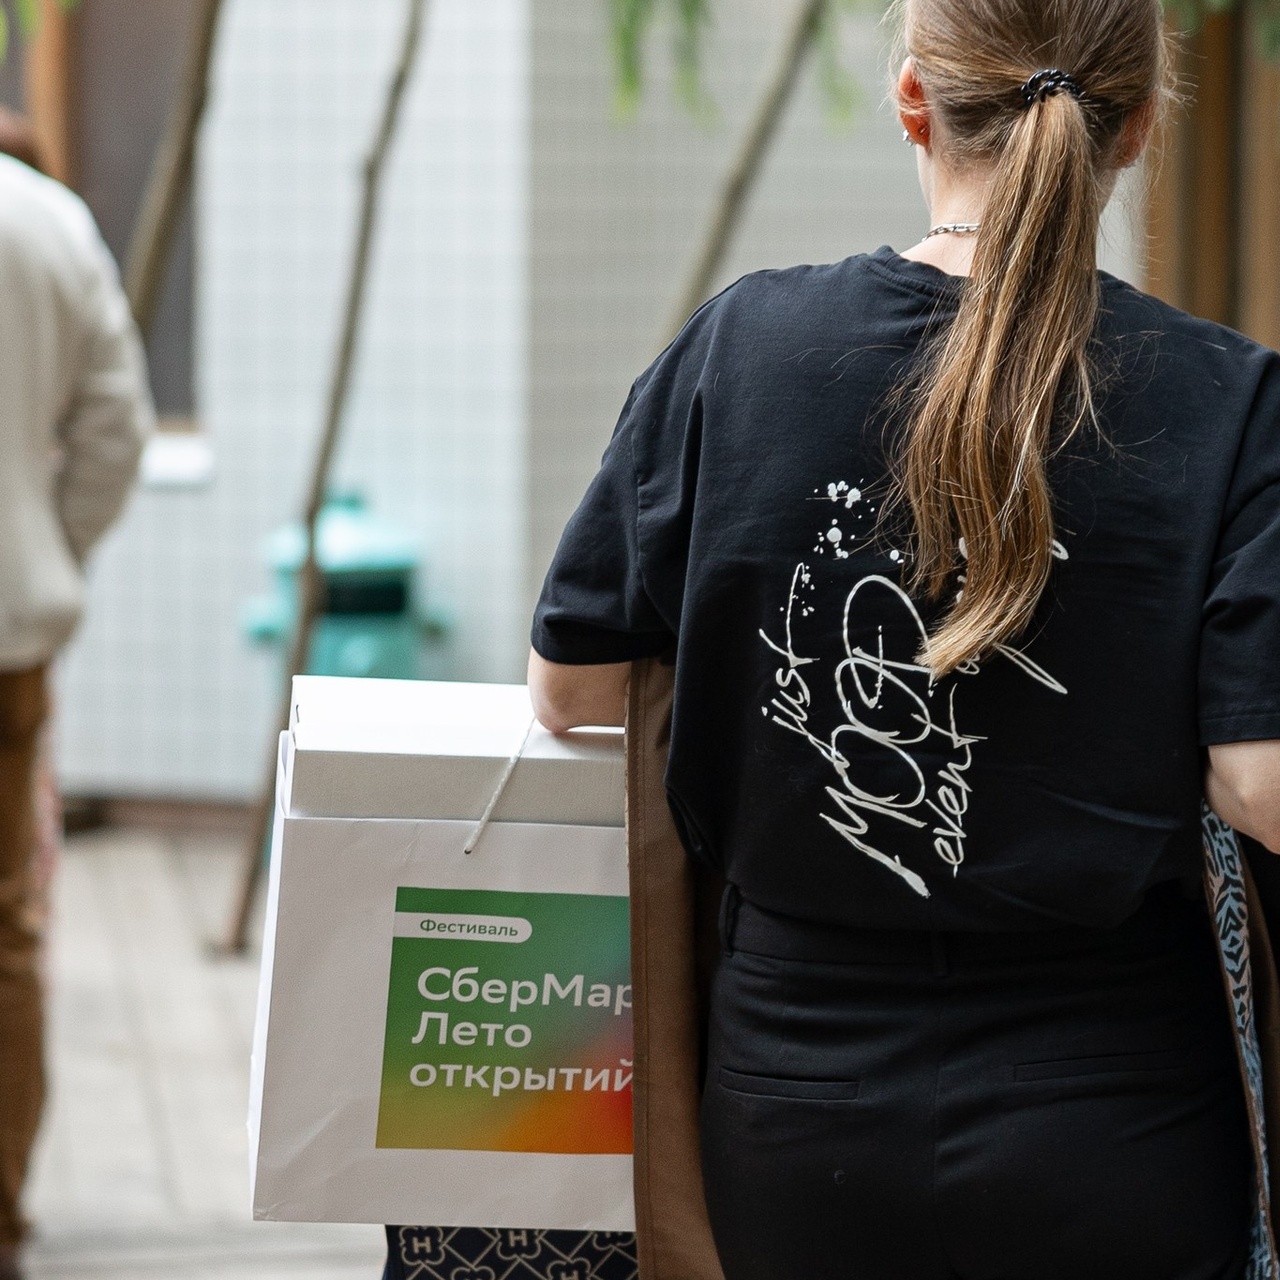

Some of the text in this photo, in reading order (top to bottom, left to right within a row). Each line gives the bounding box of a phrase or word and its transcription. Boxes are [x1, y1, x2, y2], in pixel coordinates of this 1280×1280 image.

[759, 562, 850, 768] just
[911, 683, 989, 878] event
[419, 918, 519, 937] Фестиваль
[412, 1011, 532, 1048] Лето
[408, 1058, 634, 1097] открытий
